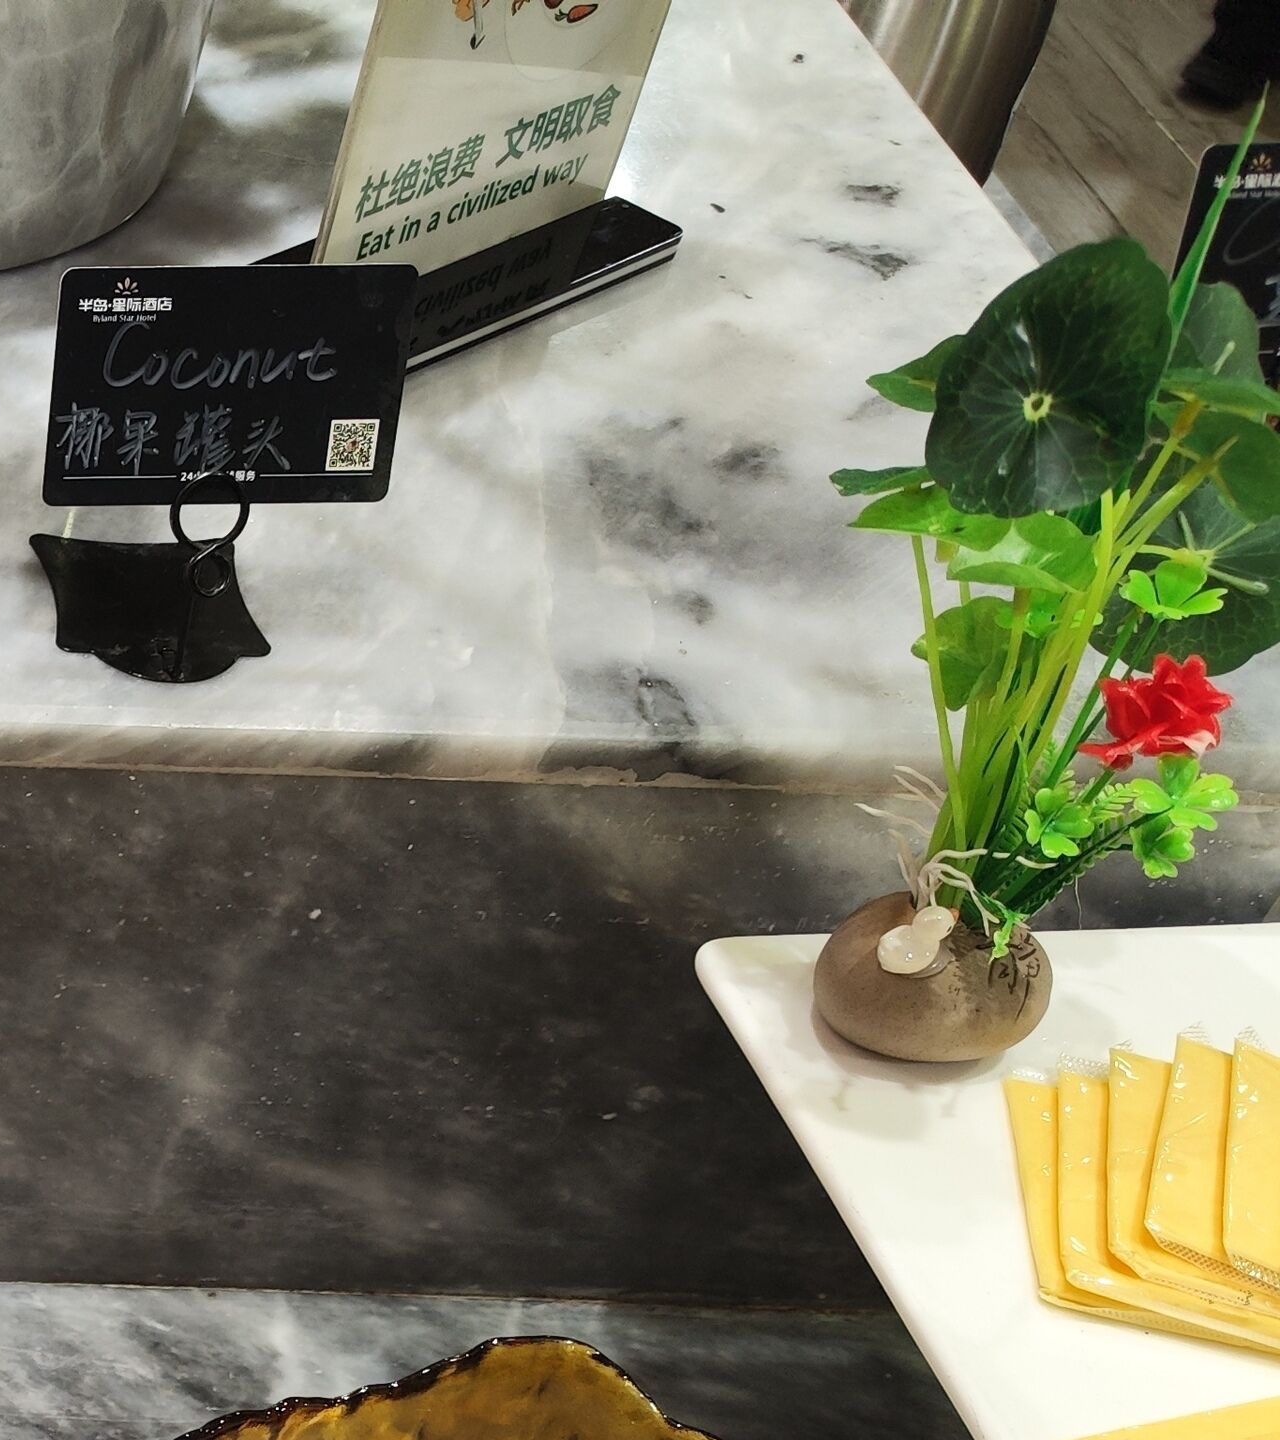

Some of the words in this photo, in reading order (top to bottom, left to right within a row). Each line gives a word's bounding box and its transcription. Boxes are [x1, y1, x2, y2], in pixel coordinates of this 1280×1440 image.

[355, 134, 485, 223] 杜绝浪费
[495, 84, 621, 168] 文明取食
[356, 225, 395, 260] Eat
[398, 216, 422, 244] in
[426, 211, 441, 232] a
[447, 164, 541, 224] civilized
[543, 153, 589, 186] way
[103, 321, 338, 390] Coconut
